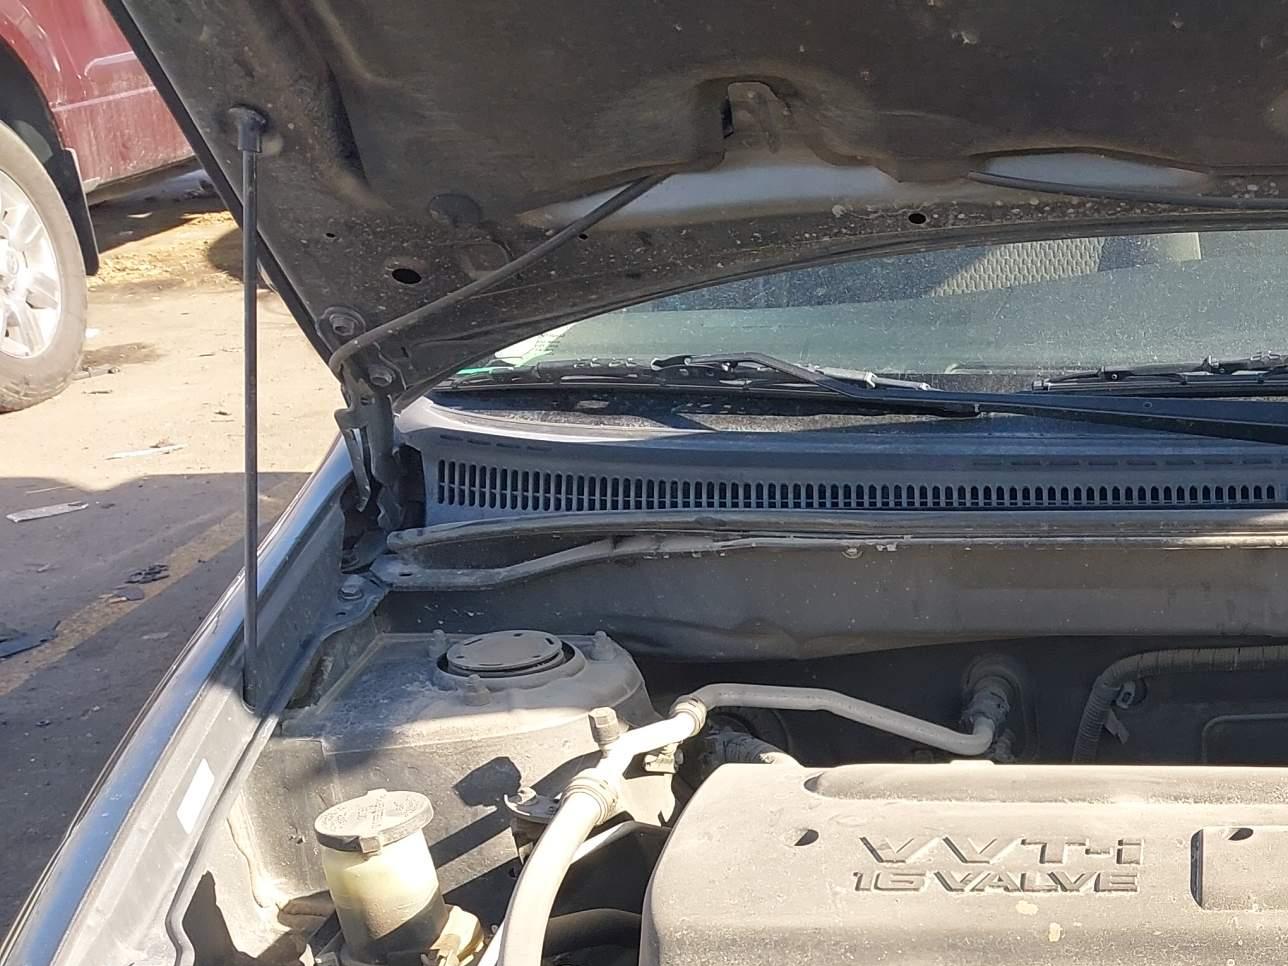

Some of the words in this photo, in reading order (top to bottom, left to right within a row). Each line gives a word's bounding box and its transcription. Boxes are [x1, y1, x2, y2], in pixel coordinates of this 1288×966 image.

[859, 836, 1143, 865] VVT-i
[853, 871, 926, 892] 16
[933, 871, 1138, 893] VALVE
